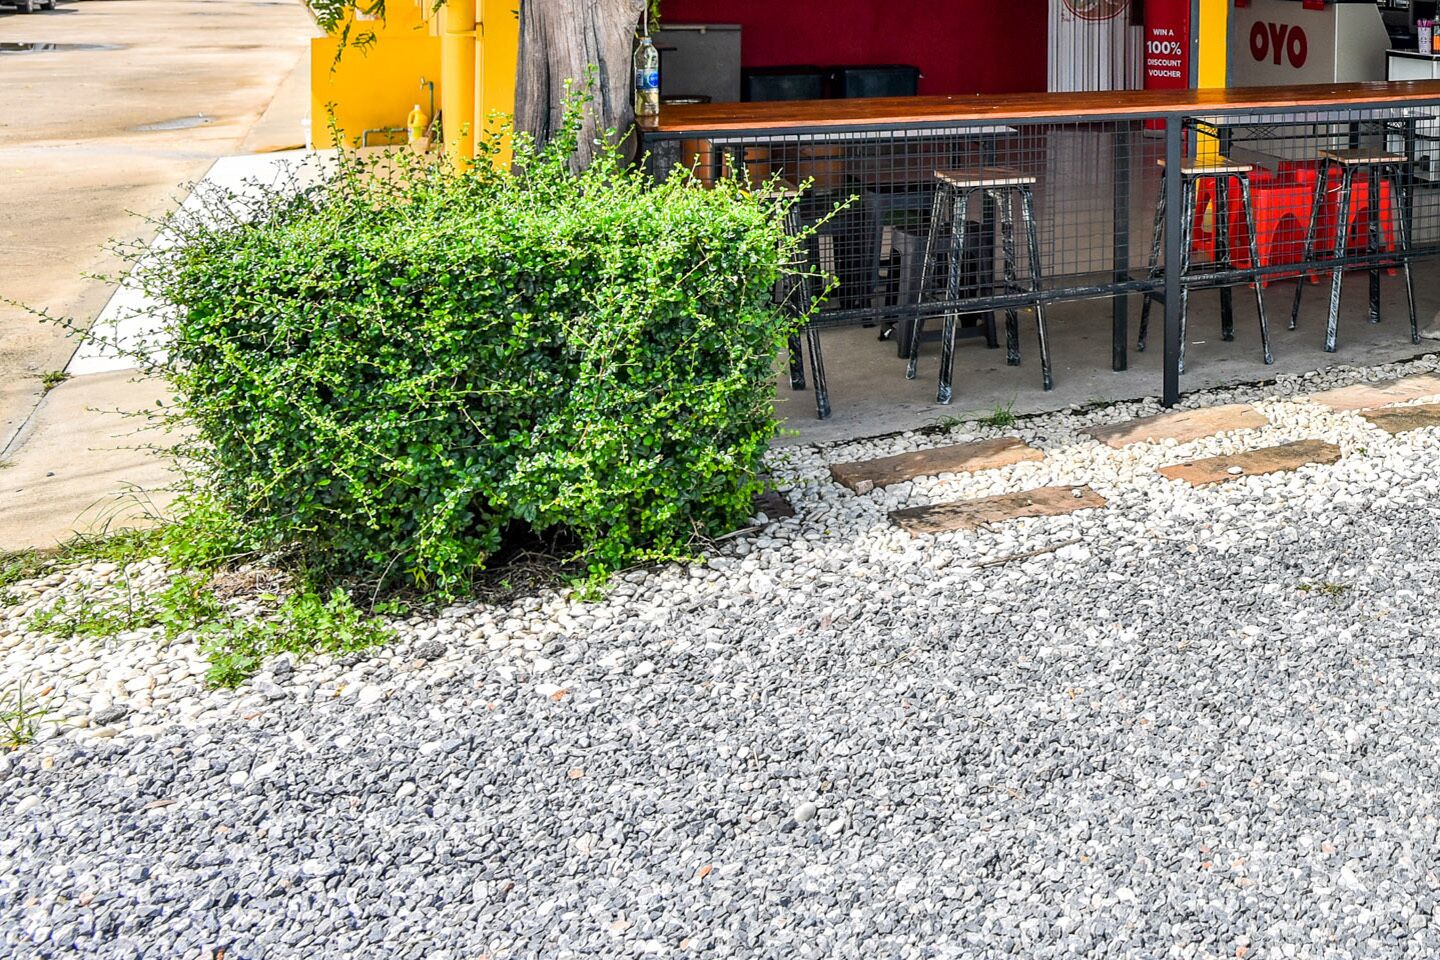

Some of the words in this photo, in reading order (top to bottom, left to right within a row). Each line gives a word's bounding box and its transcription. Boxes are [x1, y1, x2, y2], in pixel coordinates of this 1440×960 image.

[1153, 28, 1167, 36] WIN
[1147, 40, 1182, 55] 100%
[1249, 21, 1308, 69] OYO
[1147, 58, 1182, 67] DISCOUNT
[1148, 69, 1182, 78] VOUCHER
